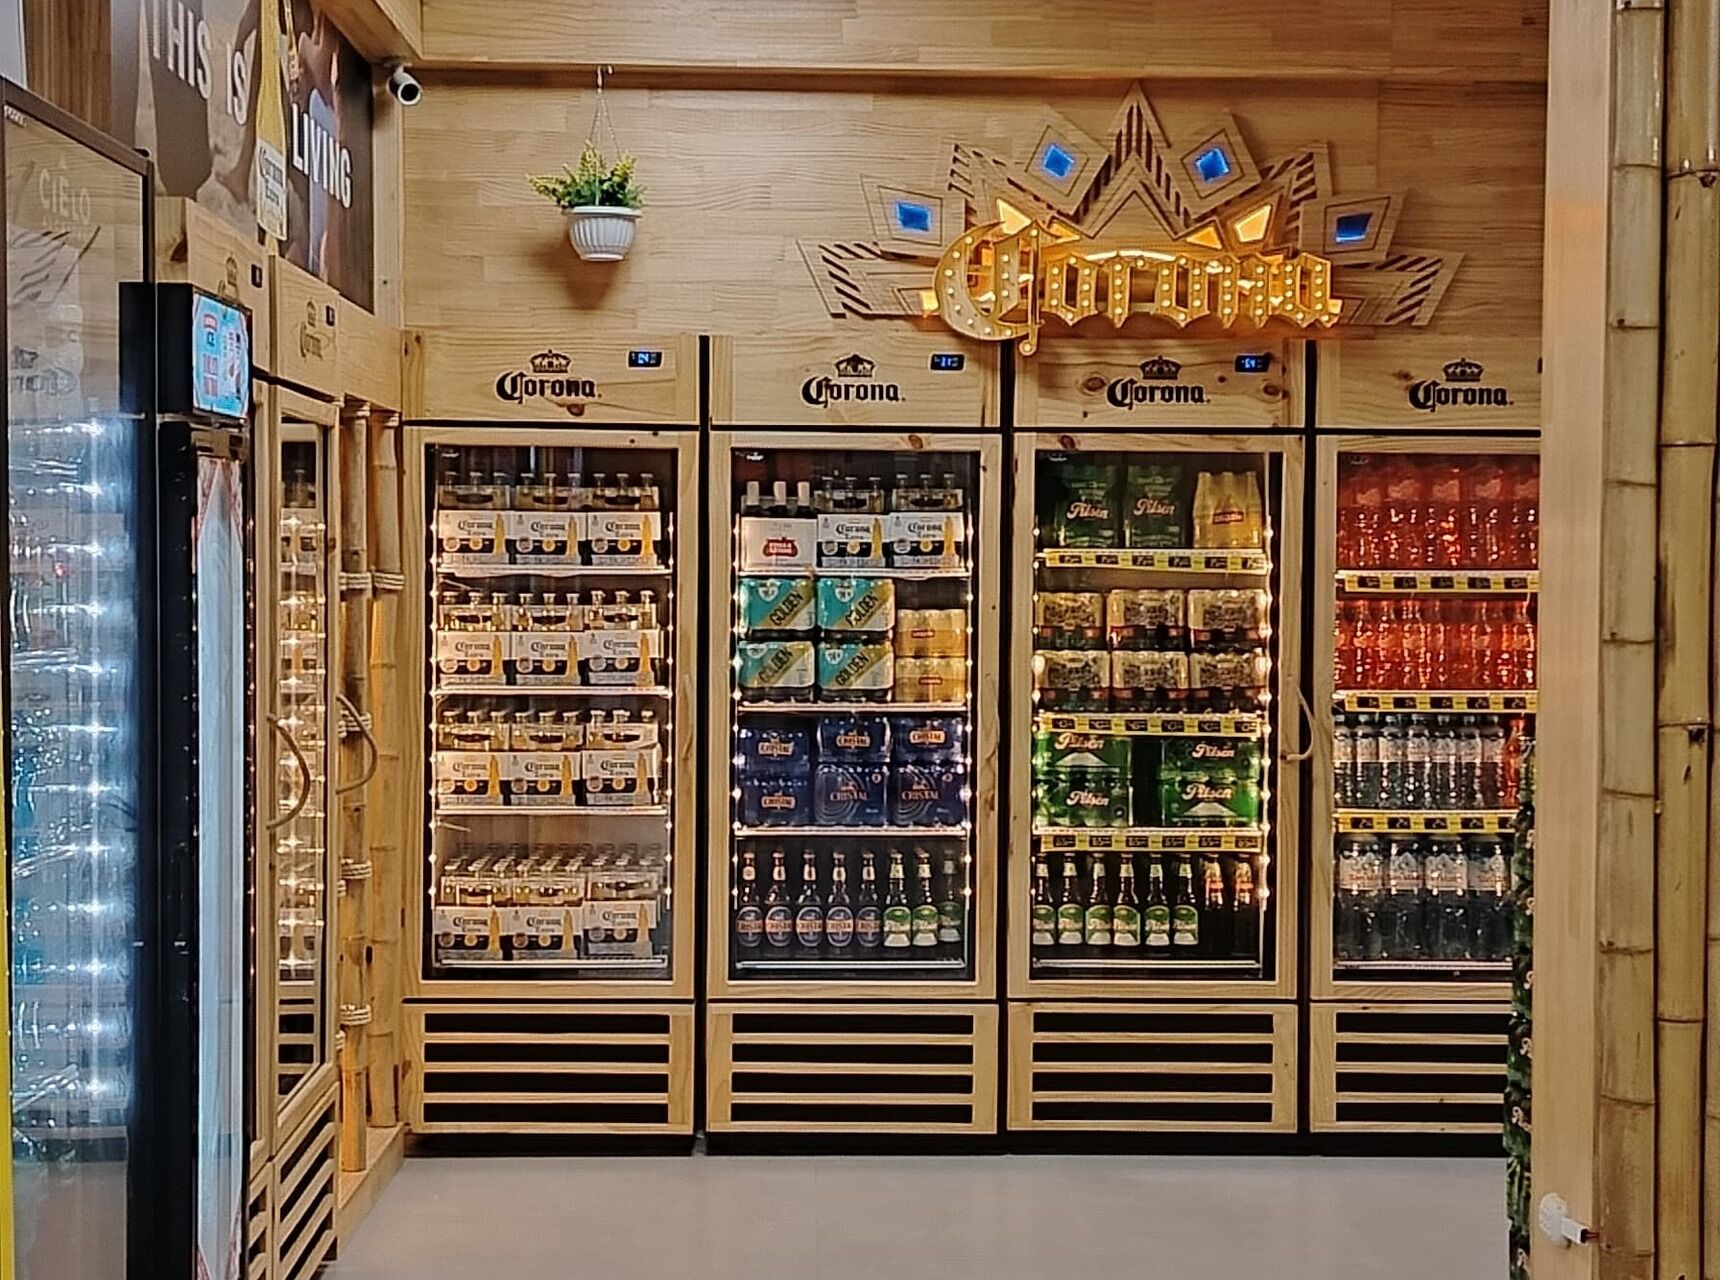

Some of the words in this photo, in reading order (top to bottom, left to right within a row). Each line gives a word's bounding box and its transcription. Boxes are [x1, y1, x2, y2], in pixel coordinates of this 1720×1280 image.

[226, 42, 247, 126] IS
[291, 102, 352, 208] LIVING
[934, 219, 1343, 356] Corona
[1066, 501, 1110, 519] Pilsen
[1133, 498, 1175, 516] Pilsen
[769, 592, 804, 626] GOLDEN
[835, 653, 870, 686] GOLDEN
[838, 736, 869, 746] CRISTAL
[912, 732, 943, 742] CRISTAL
[1192, 744, 1235, 758] Pilsen
[830, 792, 868, 801] CRISTAL
[902, 791, 939, 800] CRISTAL
[1066, 791, 1110, 806] Pilsen
[1182, 784, 1233, 800] Pilsen
[763, 798, 794, 807] CRISTAL
